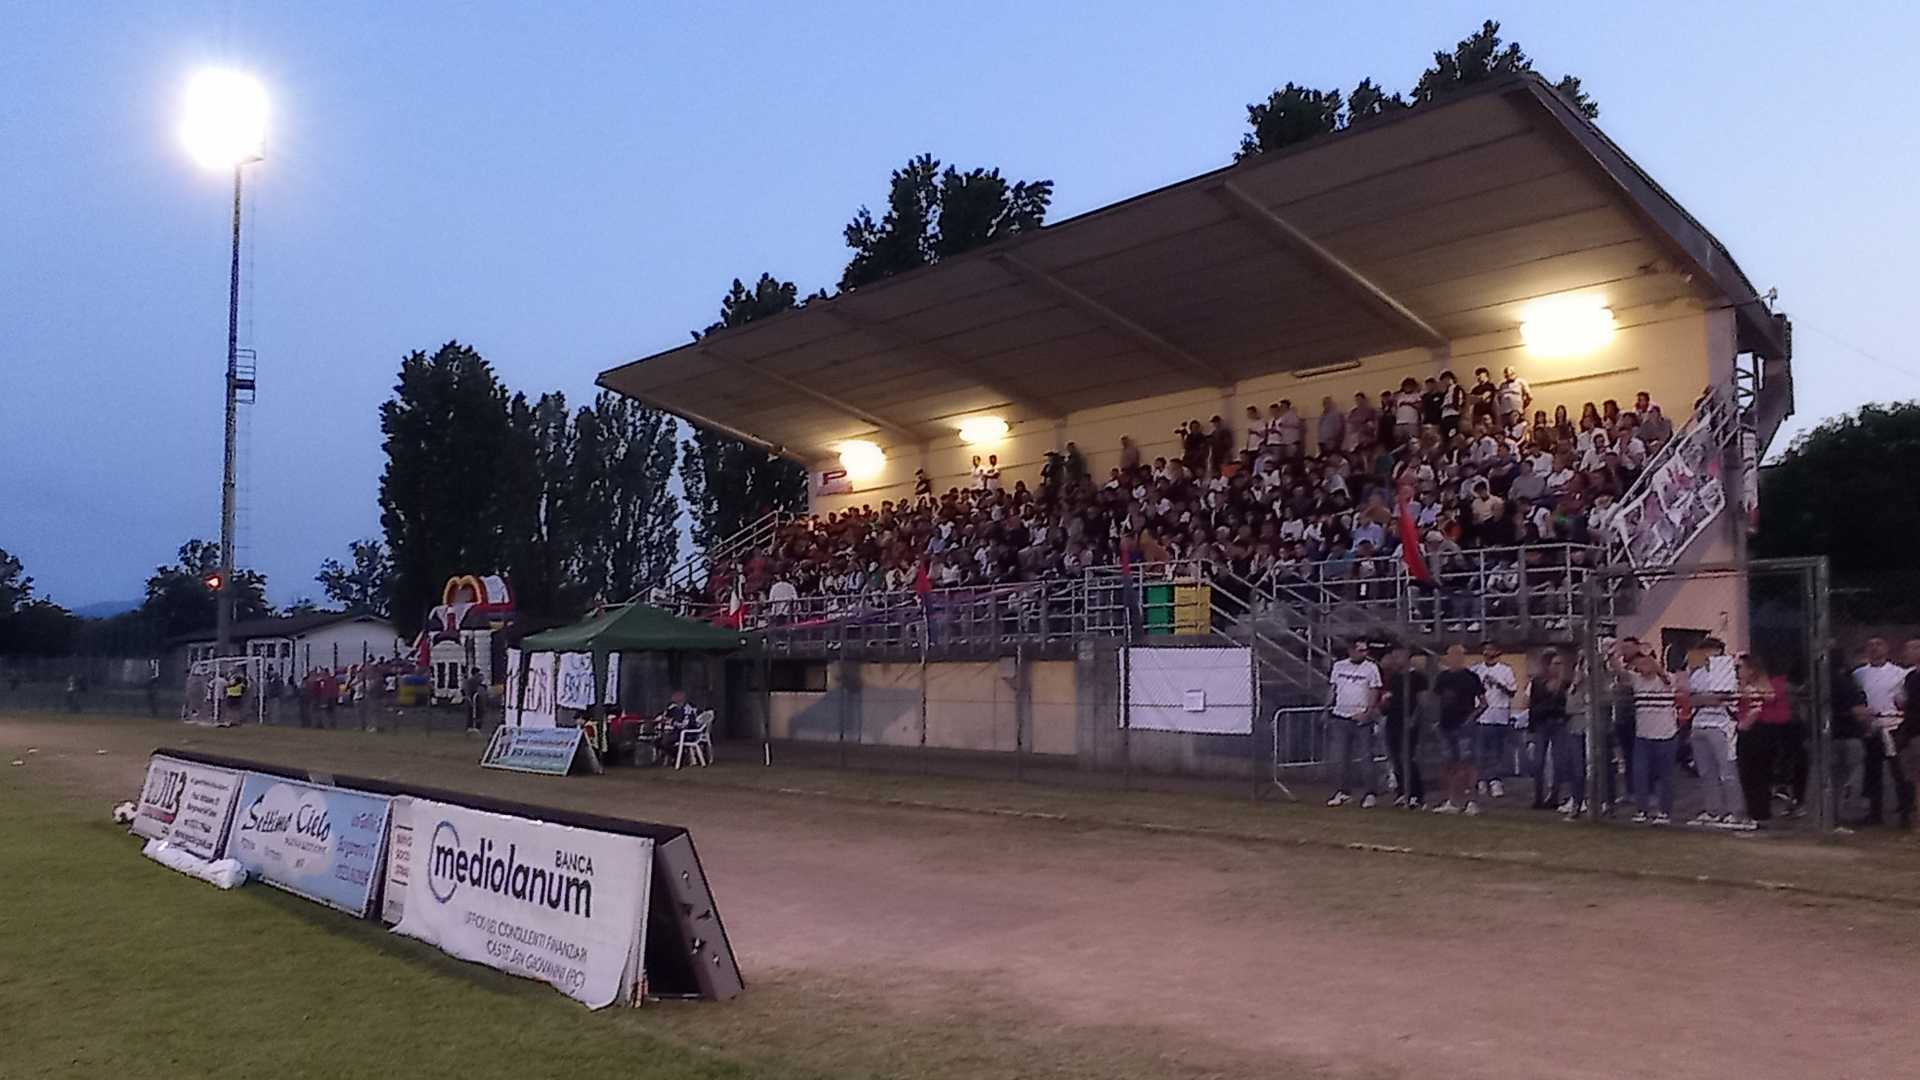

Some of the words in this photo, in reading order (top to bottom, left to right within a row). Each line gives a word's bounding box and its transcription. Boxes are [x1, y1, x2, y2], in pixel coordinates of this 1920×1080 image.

[296, 803, 331, 842] Cielo
[434, 837, 592, 918] mediolanum
[555, 850, 593, 876] BANCA
